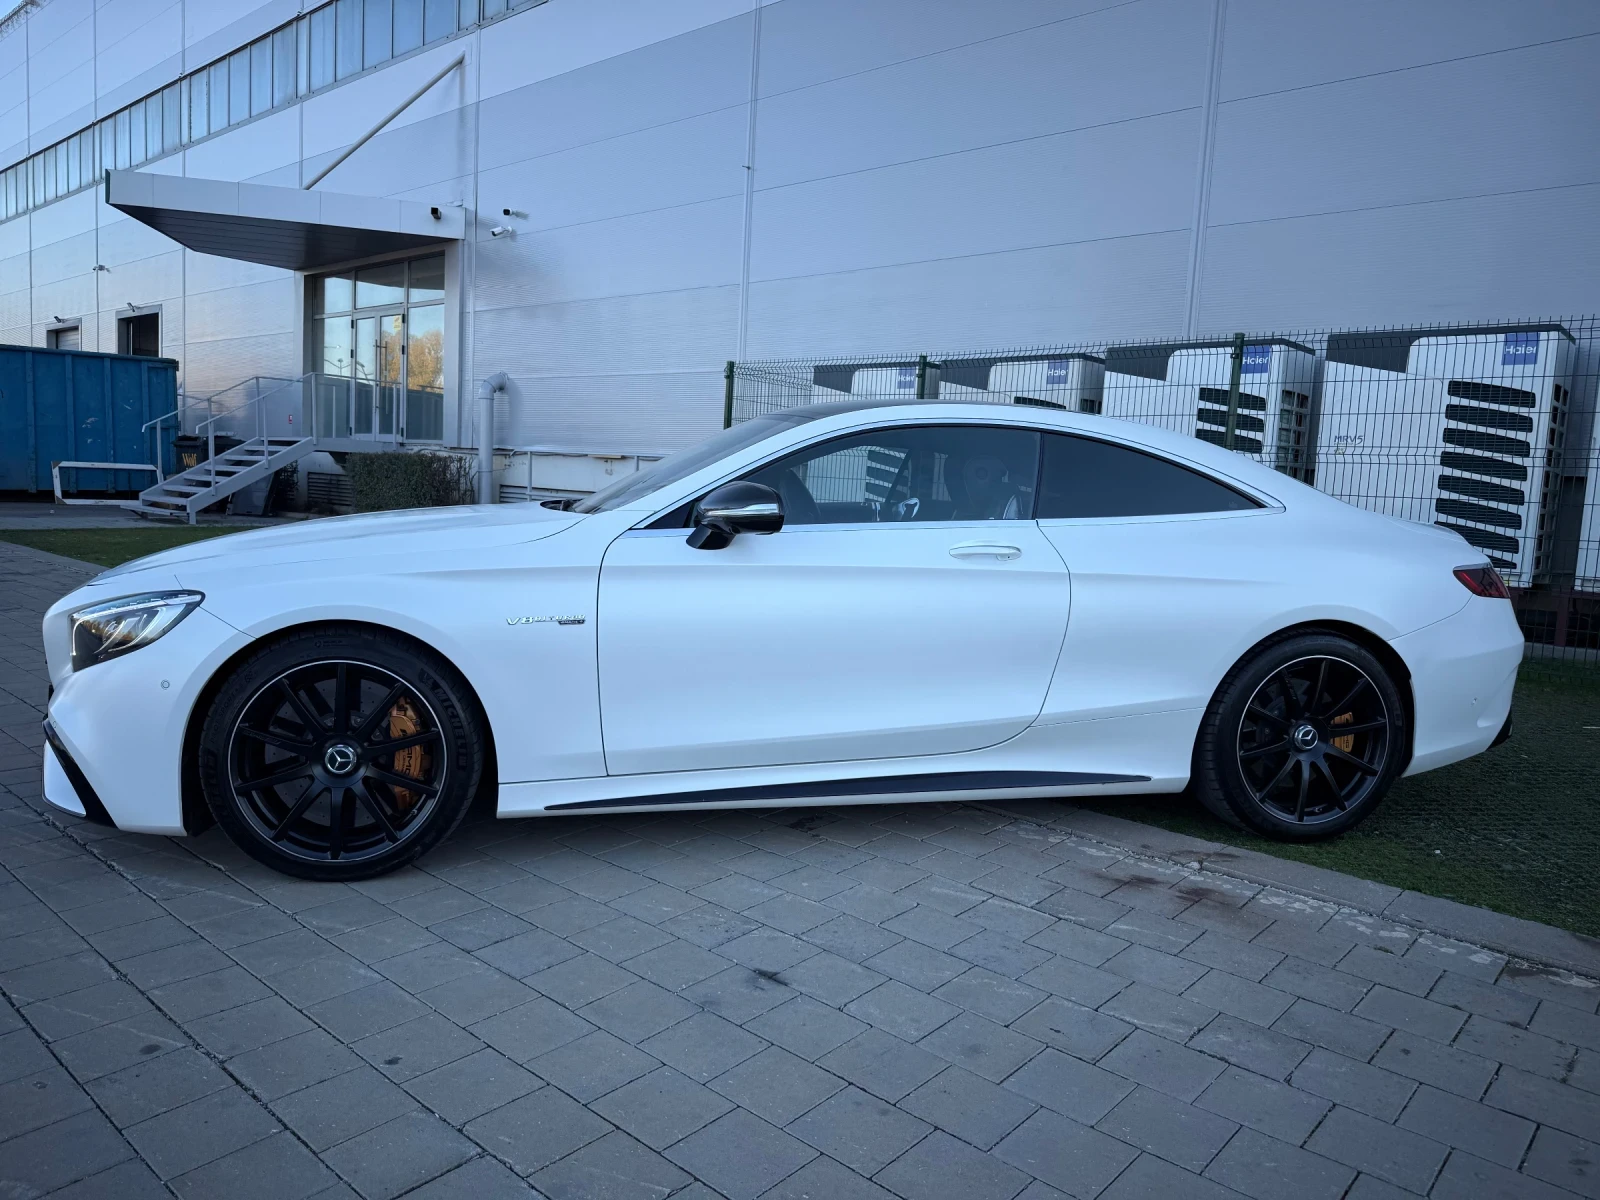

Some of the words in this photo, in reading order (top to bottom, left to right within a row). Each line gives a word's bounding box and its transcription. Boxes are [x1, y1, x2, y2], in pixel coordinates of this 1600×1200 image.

[1503, 344, 1537, 355] Haier
[1242, 356, 1269, 365] Haier
[506, 616, 533, 625] V8
[435, 688, 467, 767] MICHELIN
